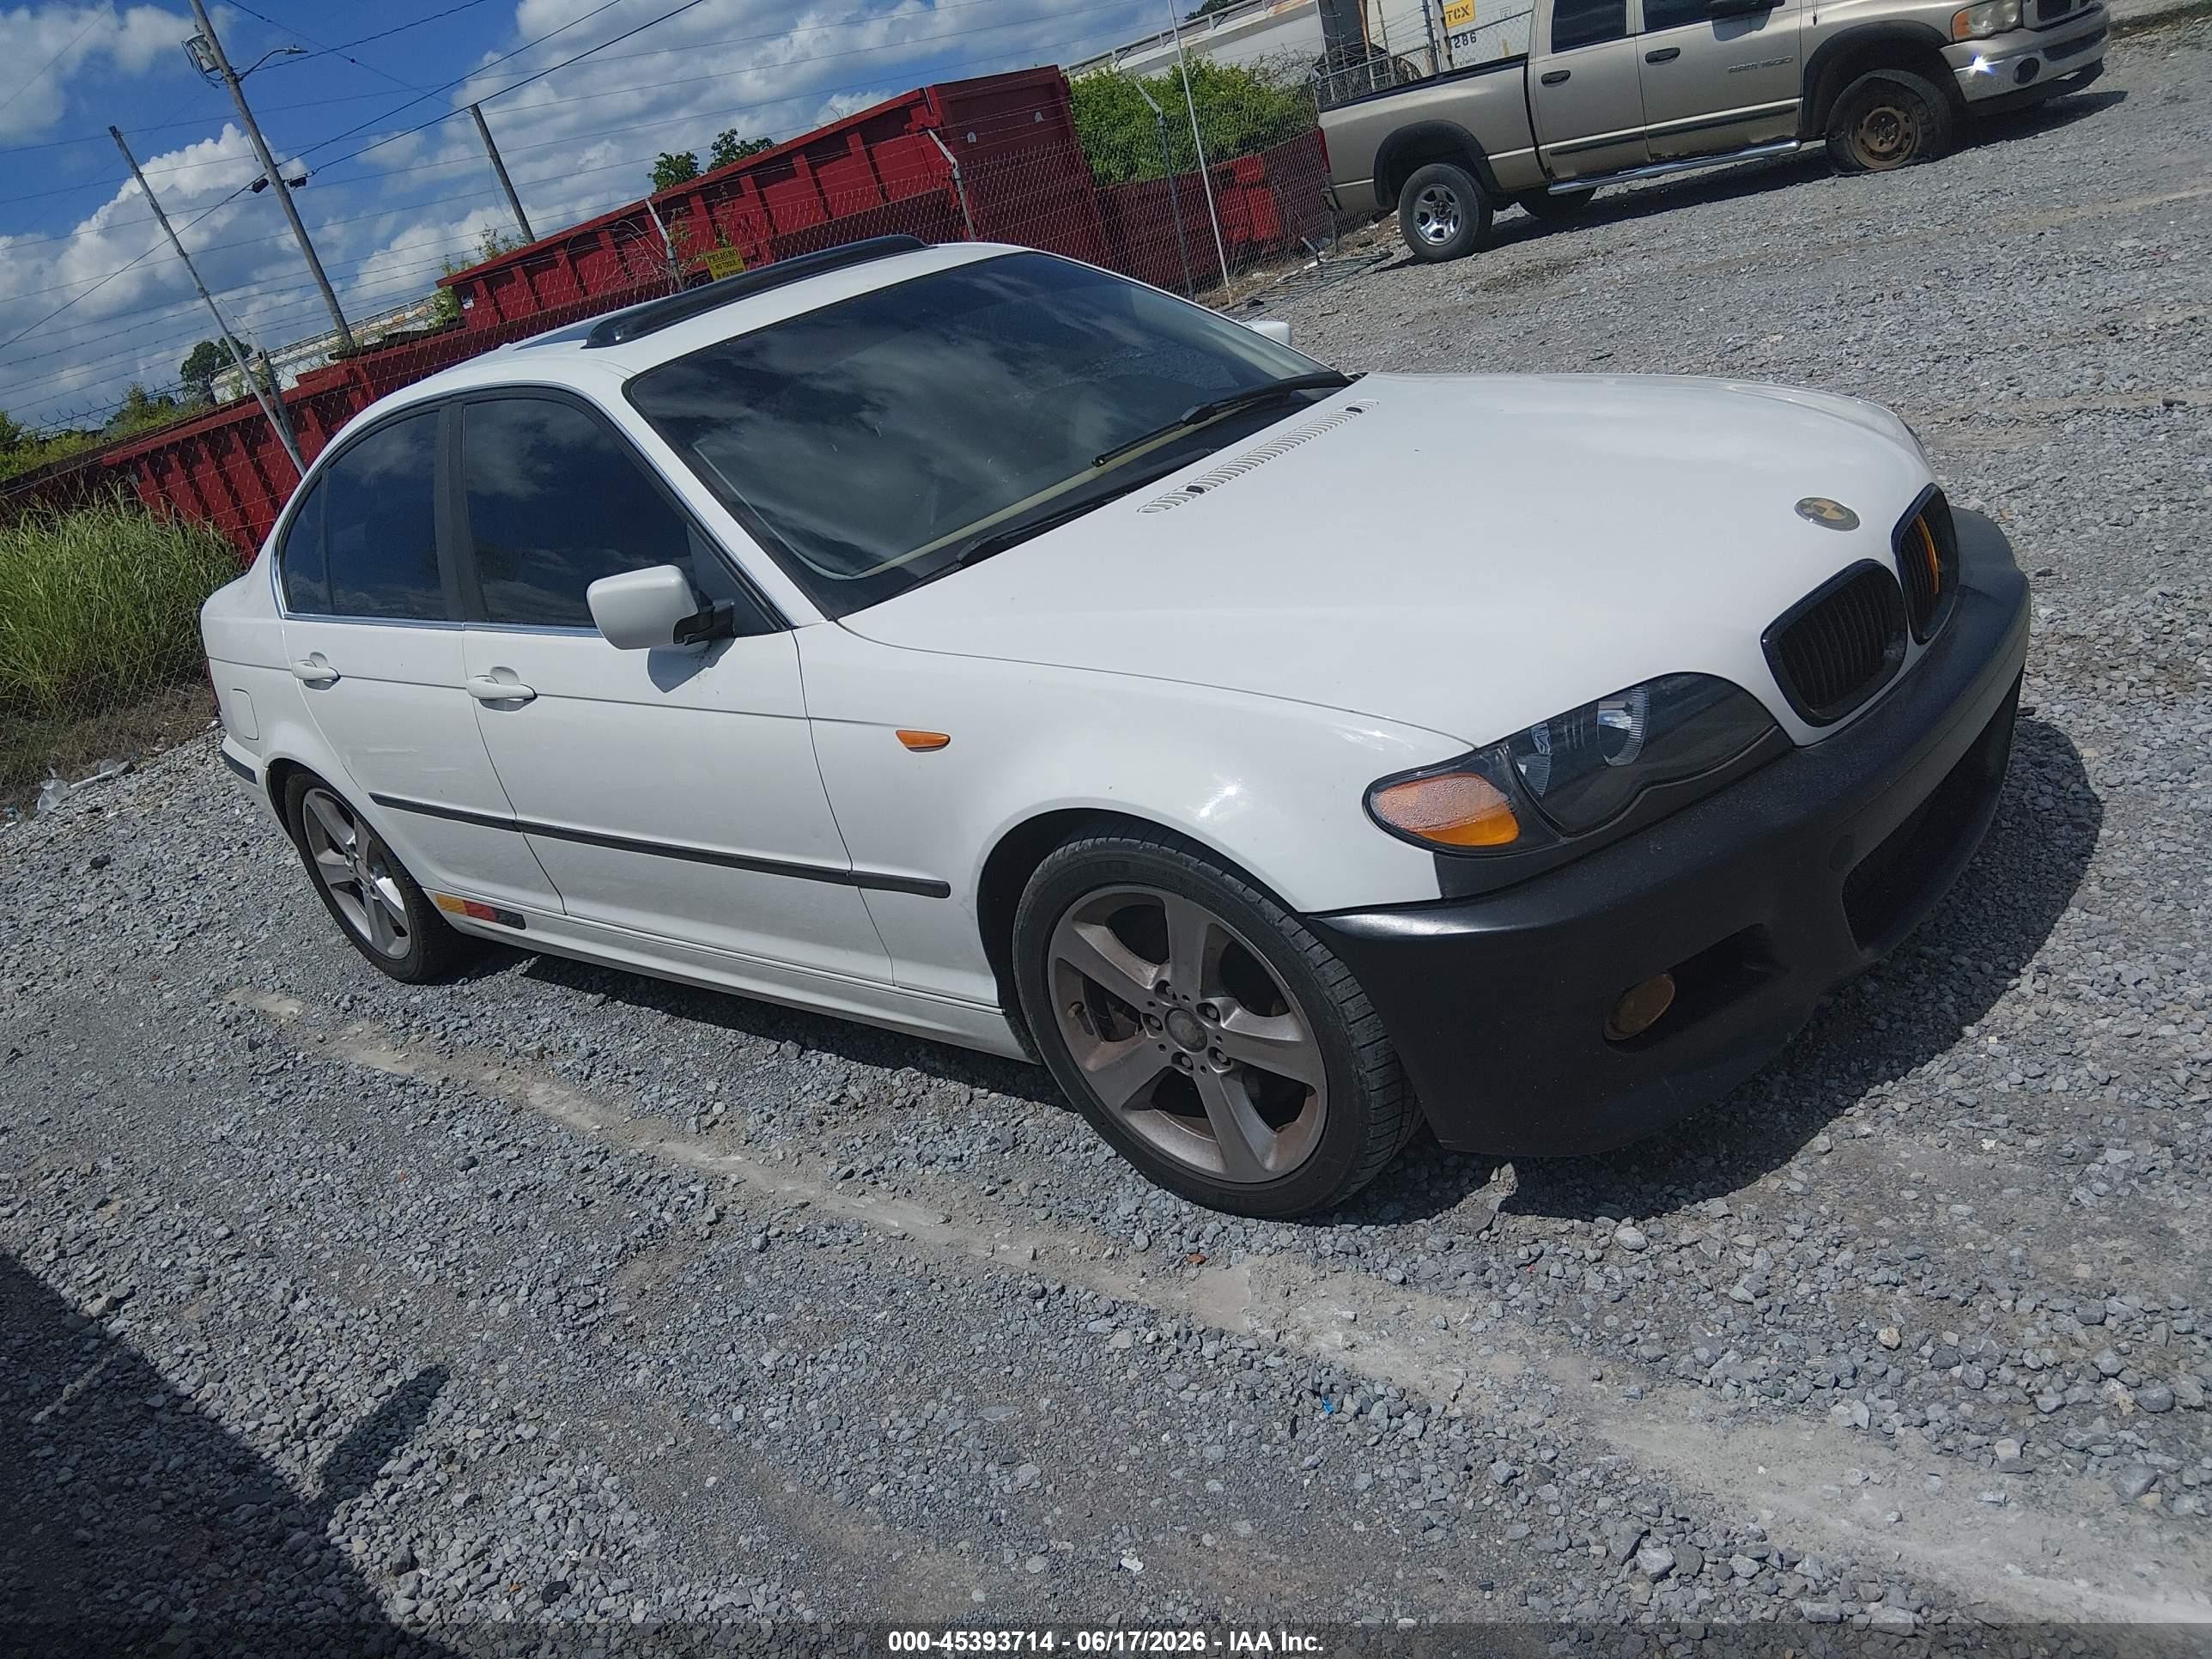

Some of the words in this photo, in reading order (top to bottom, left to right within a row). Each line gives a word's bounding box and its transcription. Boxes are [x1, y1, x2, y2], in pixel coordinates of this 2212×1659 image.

[1446, 4, 1470, 22] TCX
[1454, 33, 1477, 48] 286
[707, 249, 738, 263] PELIGRO
